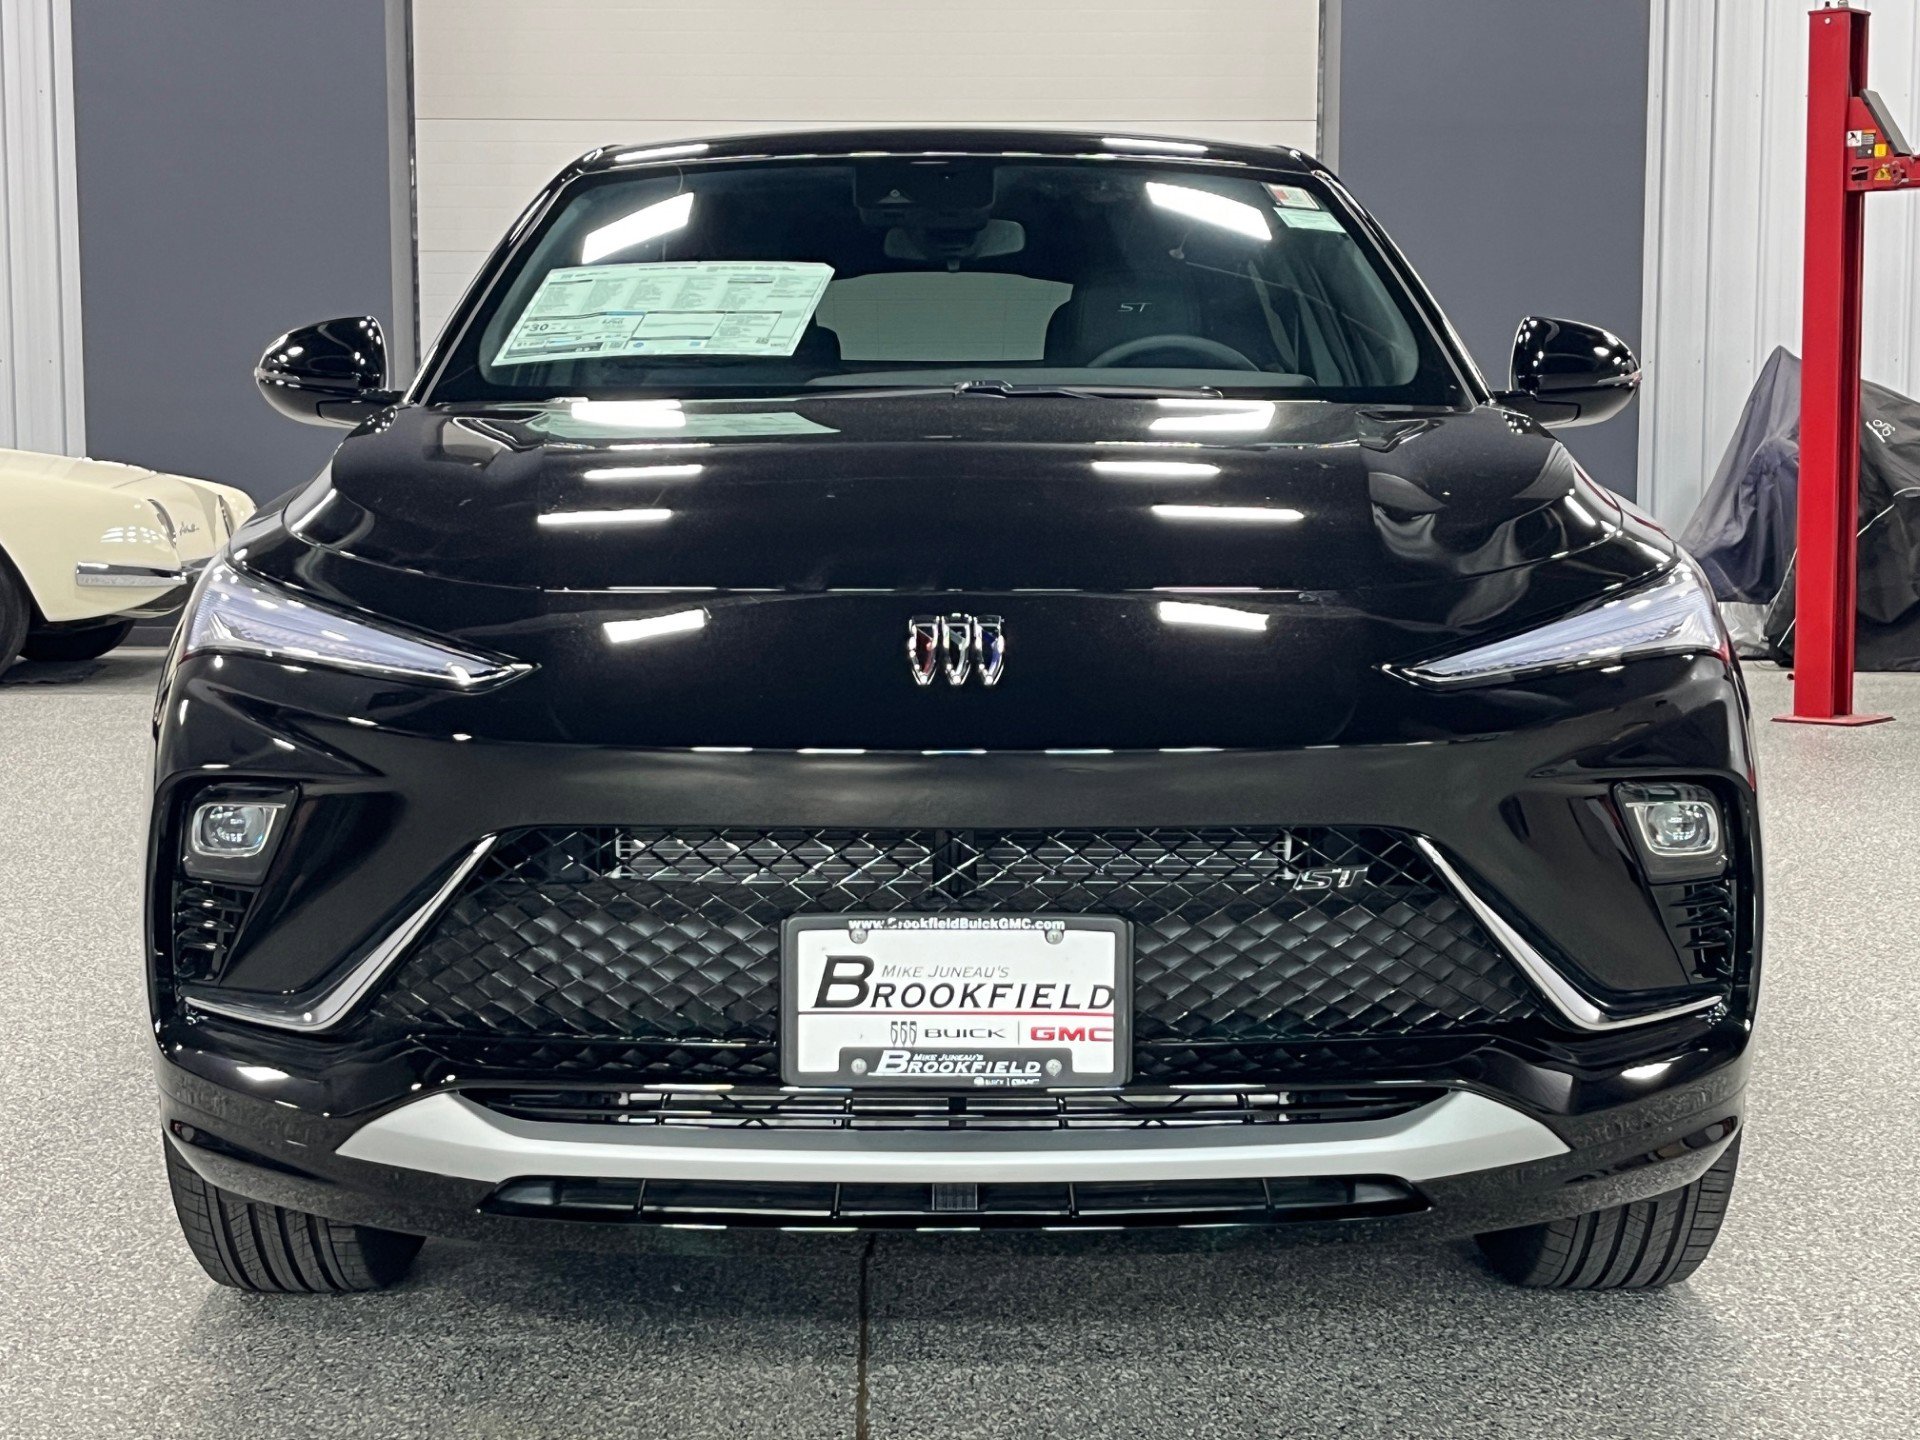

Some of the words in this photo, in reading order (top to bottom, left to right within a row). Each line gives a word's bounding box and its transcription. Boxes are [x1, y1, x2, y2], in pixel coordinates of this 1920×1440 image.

[1117, 302, 1153, 313] ST
[1293, 866, 1369, 891] ST
[811, 954, 1115, 1010] BROOKFIELD
[924, 1027, 1007, 1039] BUICK
[1030, 1026, 1114, 1042] GMC
[875, 1050, 1041, 1074] BROOKFIELD
